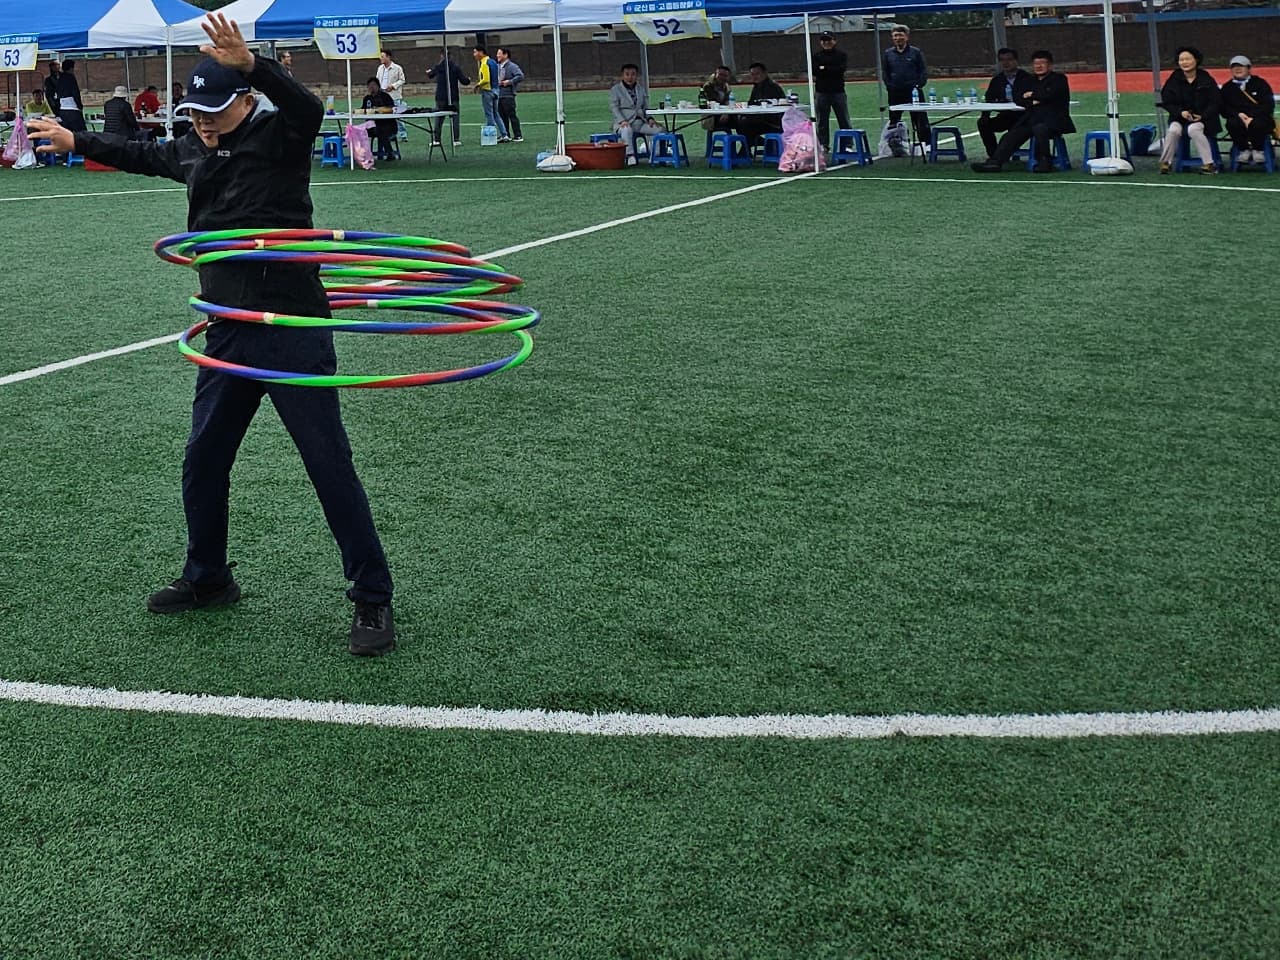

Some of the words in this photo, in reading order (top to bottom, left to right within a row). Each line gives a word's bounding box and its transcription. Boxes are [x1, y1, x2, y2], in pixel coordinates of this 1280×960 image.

[653, 18, 685, 37] 52
[336, 33, 357, 54] 53
[4, 48, 20, 66] 53
